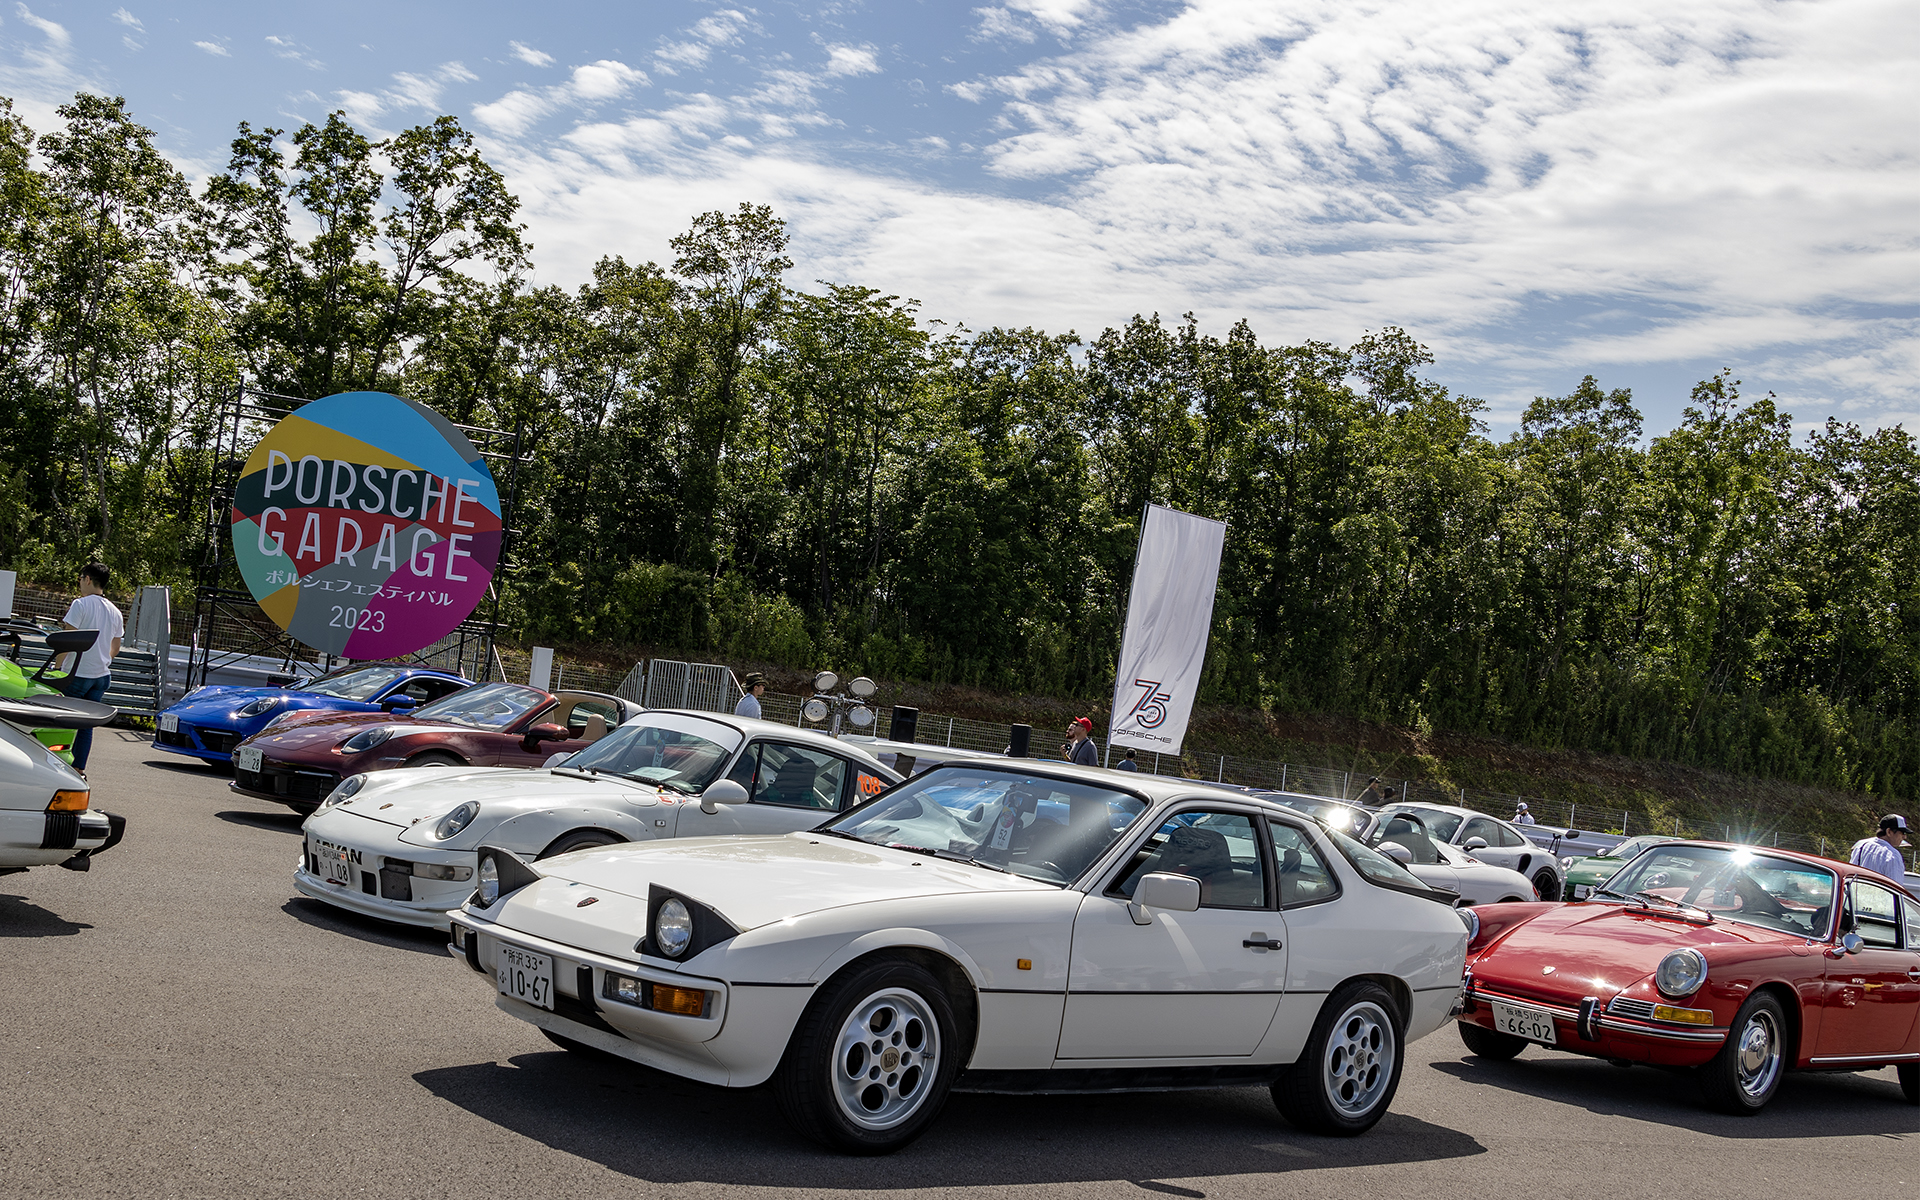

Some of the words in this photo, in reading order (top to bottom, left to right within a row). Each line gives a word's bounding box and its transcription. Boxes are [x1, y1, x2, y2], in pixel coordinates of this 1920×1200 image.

[264, 450, 480, 528] PORSCHE
[258, 506, 473, 582] GARAGE
[265, 570, 454, 606] ポルシェフェスティバル
[329, 605, 386, 632] 2023
[1128, 678, 1171, 729] 75
[252, 757, 261, 770] 28
[857, 774, 881, 795] 108
[510, 967, 549, 1004] 10-67
[1508, 1017, 1553, 1041] 66-02
